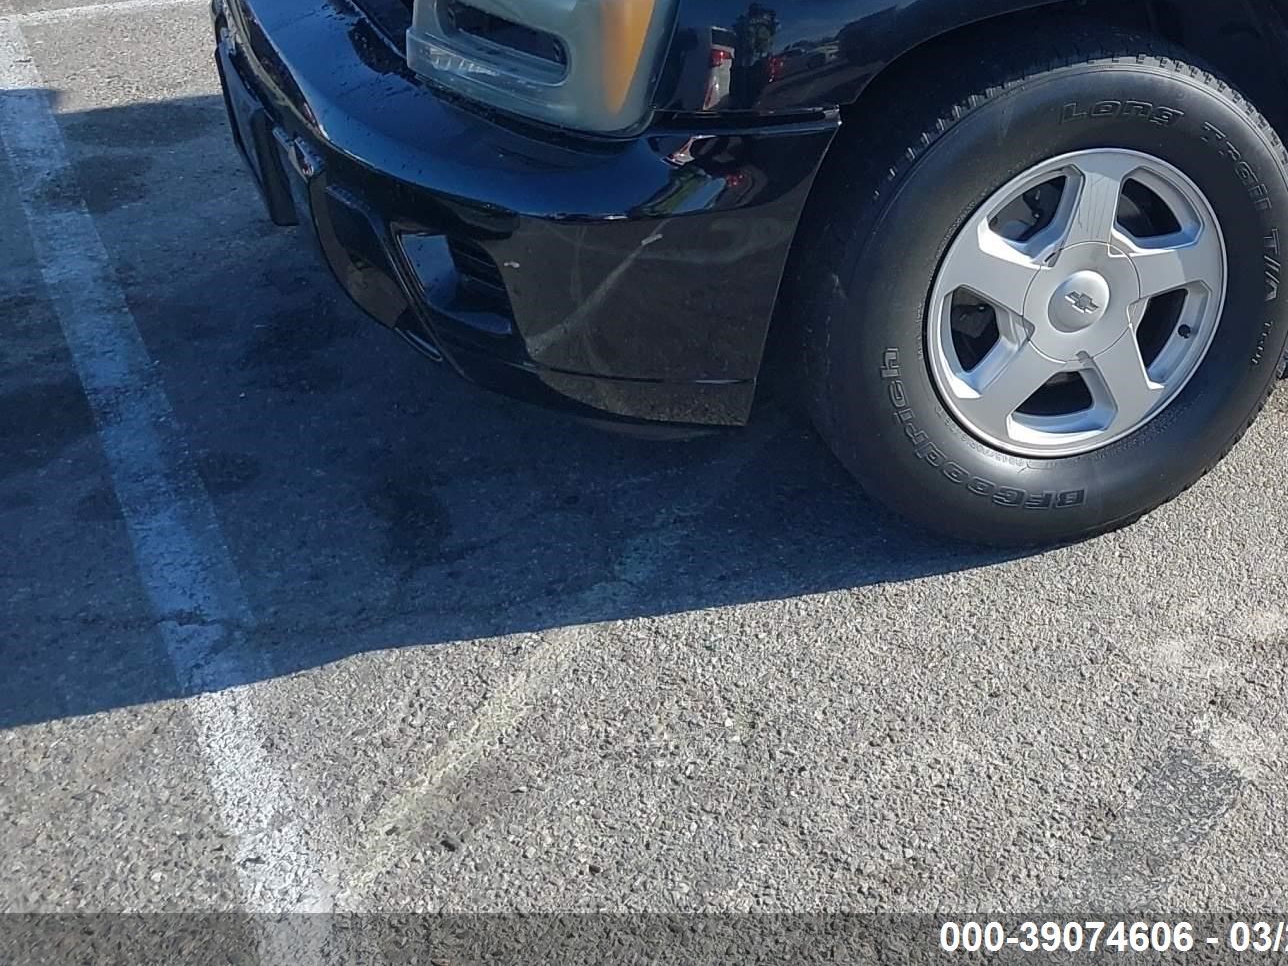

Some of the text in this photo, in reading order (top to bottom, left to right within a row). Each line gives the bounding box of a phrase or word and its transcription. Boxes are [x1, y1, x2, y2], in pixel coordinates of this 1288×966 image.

[1059, 100, 1185, 128] Long
[1201, 120, 1273, 212] Trail
[879, 346, 1089, 510] BFGoodrich
